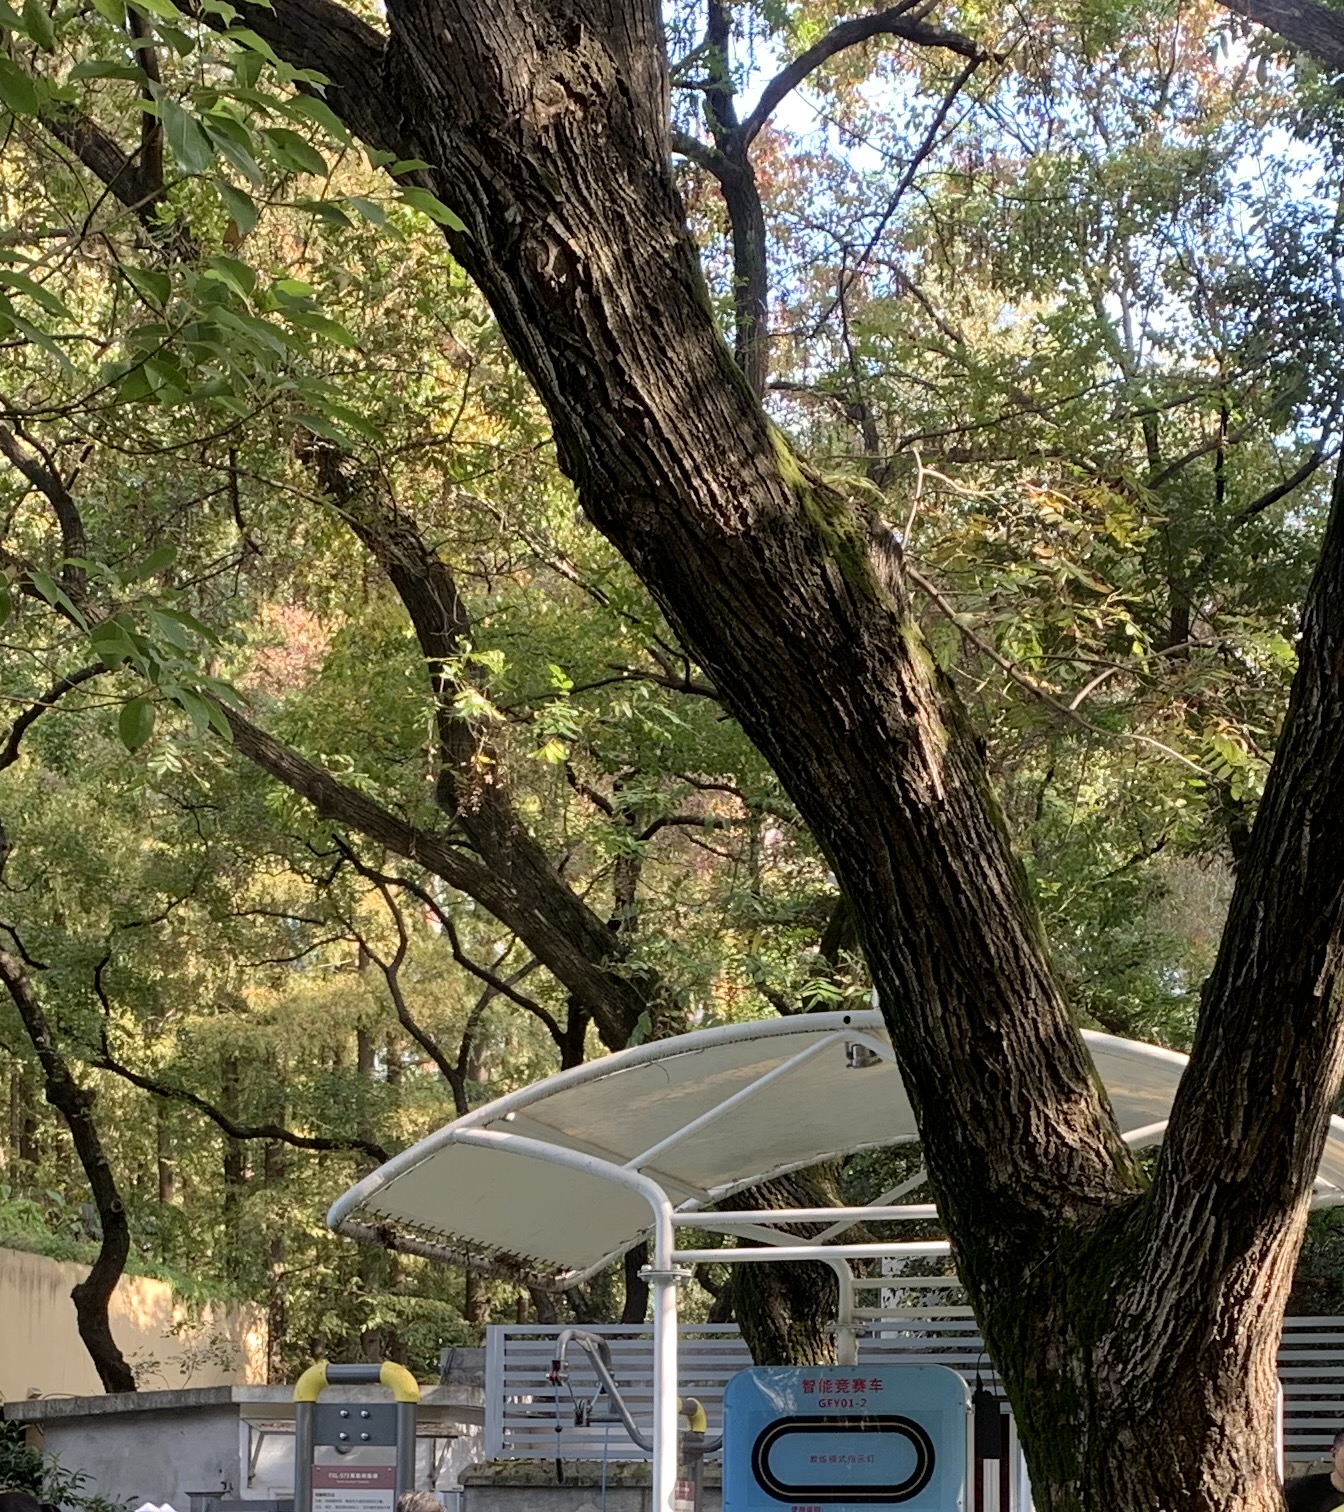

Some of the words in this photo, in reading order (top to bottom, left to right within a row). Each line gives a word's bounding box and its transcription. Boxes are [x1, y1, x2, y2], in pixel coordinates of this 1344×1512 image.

[802, 1378, 883, 1394] 智能竞赛车
[818, 1398, 867, 1408] GFY01-2
